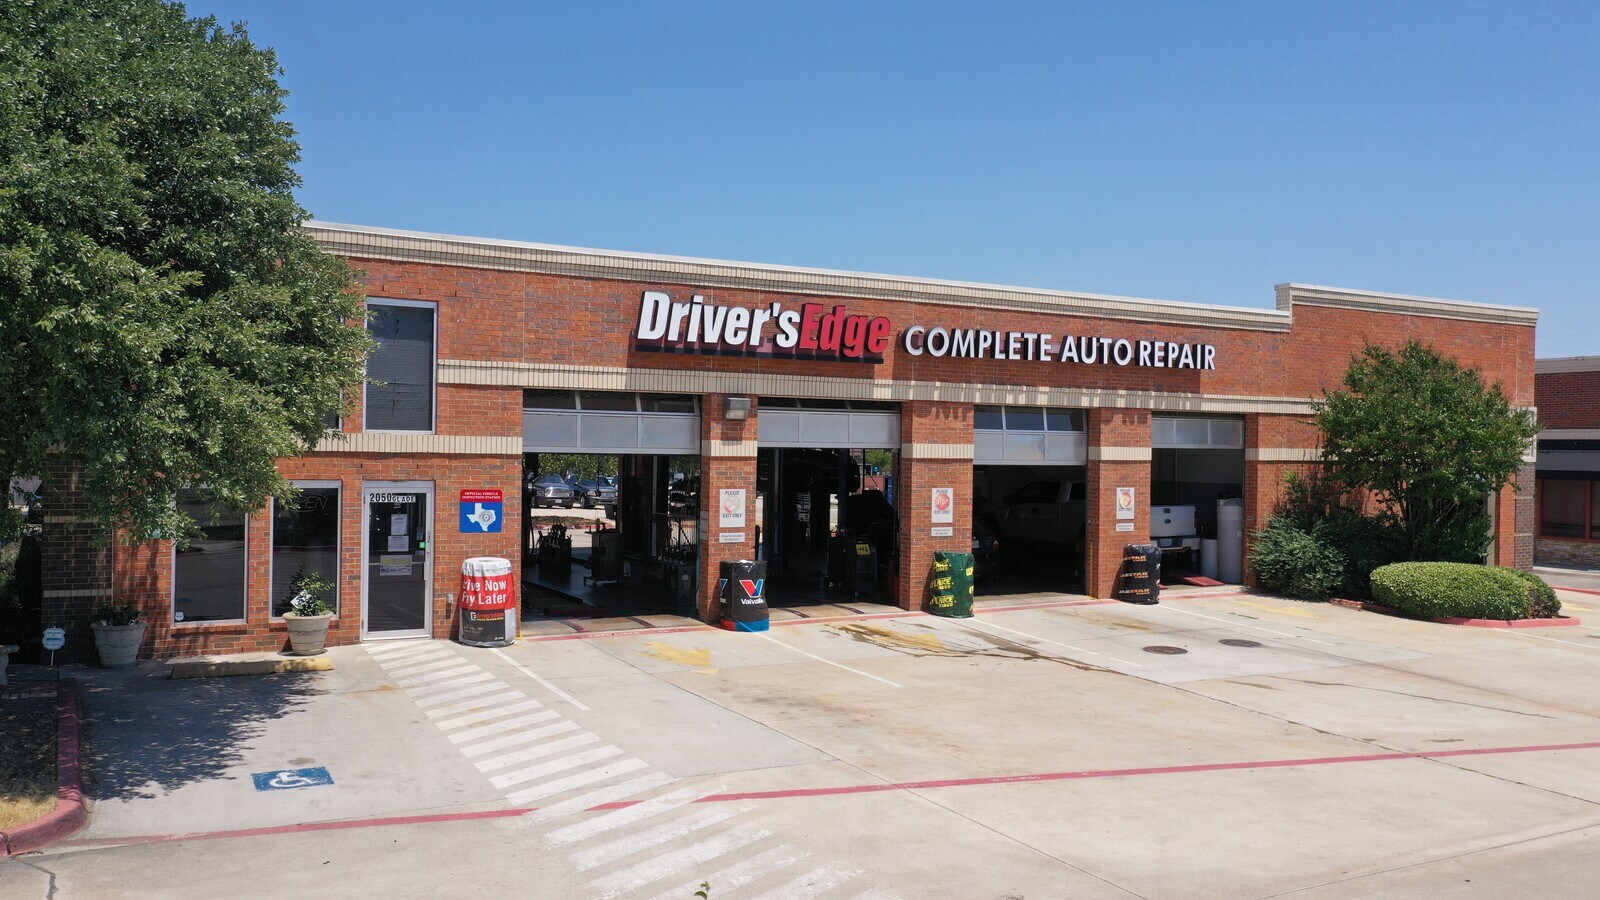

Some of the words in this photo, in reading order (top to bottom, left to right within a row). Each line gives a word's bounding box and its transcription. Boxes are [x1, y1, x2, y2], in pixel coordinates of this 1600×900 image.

[904, 325, 1052, 362] COMPLETE
[1060, 334, 1133, 366] AUTO
[1138, 340, 1216, 370] REPAIR
[369, 492, 392, 502] 2050
[484, 579, 507, 592] Now
[478, 592, 507, 605] Later
